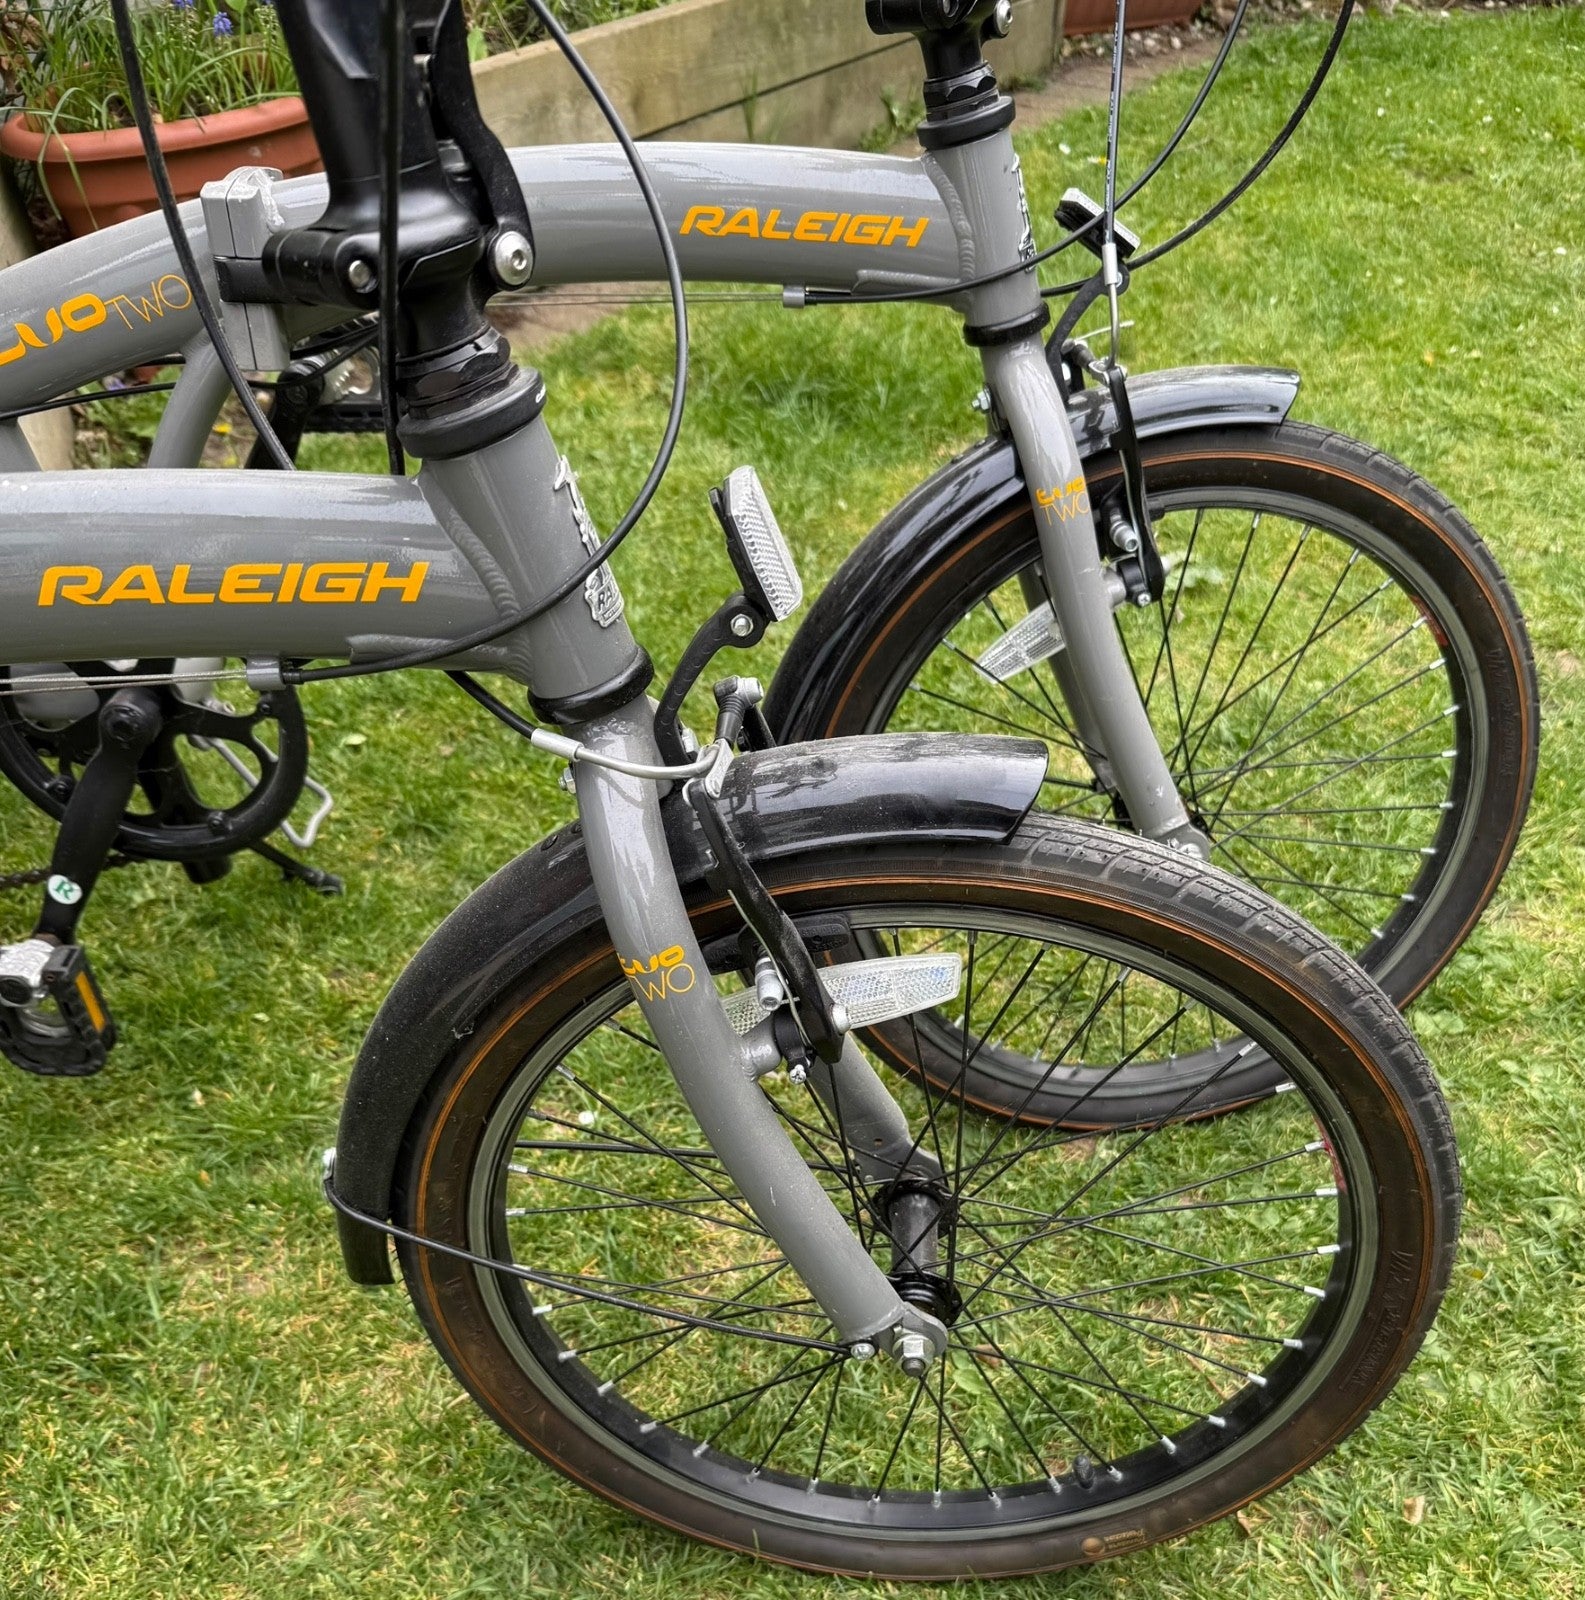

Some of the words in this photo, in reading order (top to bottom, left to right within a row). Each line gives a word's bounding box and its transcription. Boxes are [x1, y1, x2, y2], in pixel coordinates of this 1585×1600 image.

[679, 205, 929, 248] RALEIGH
[104, 274, 192, 329] TWO
[1040, 491, 1089, 527] TWO
[37, 561, 430, 607] RALEIGH
[54, 880, 74, 901] R
